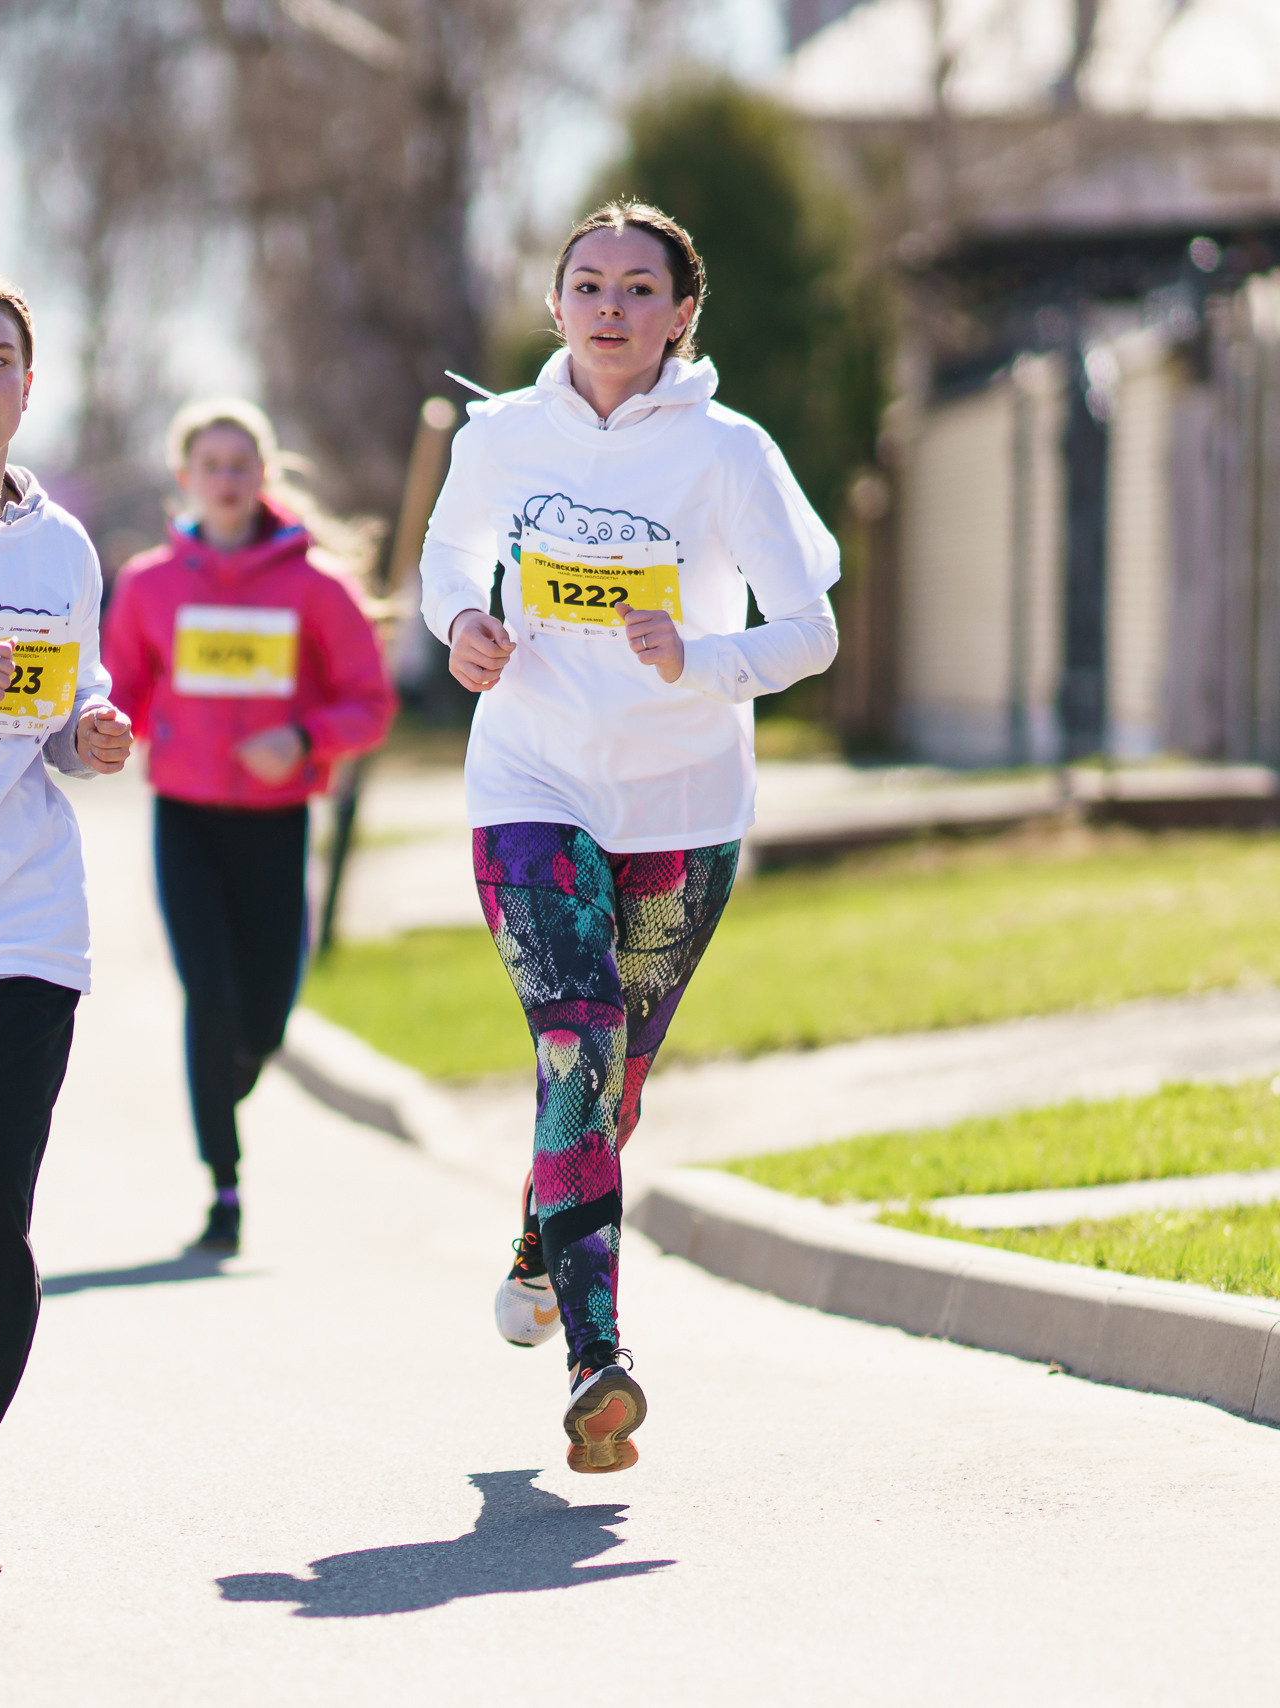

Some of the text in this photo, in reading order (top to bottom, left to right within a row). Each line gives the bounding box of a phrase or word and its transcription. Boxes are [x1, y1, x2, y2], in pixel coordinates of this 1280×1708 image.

[547, 579, 629, 608] 1222
[14, 644, 61, 654] ОЛУМАРАФОН
[3, 665, 44, 695] 23
